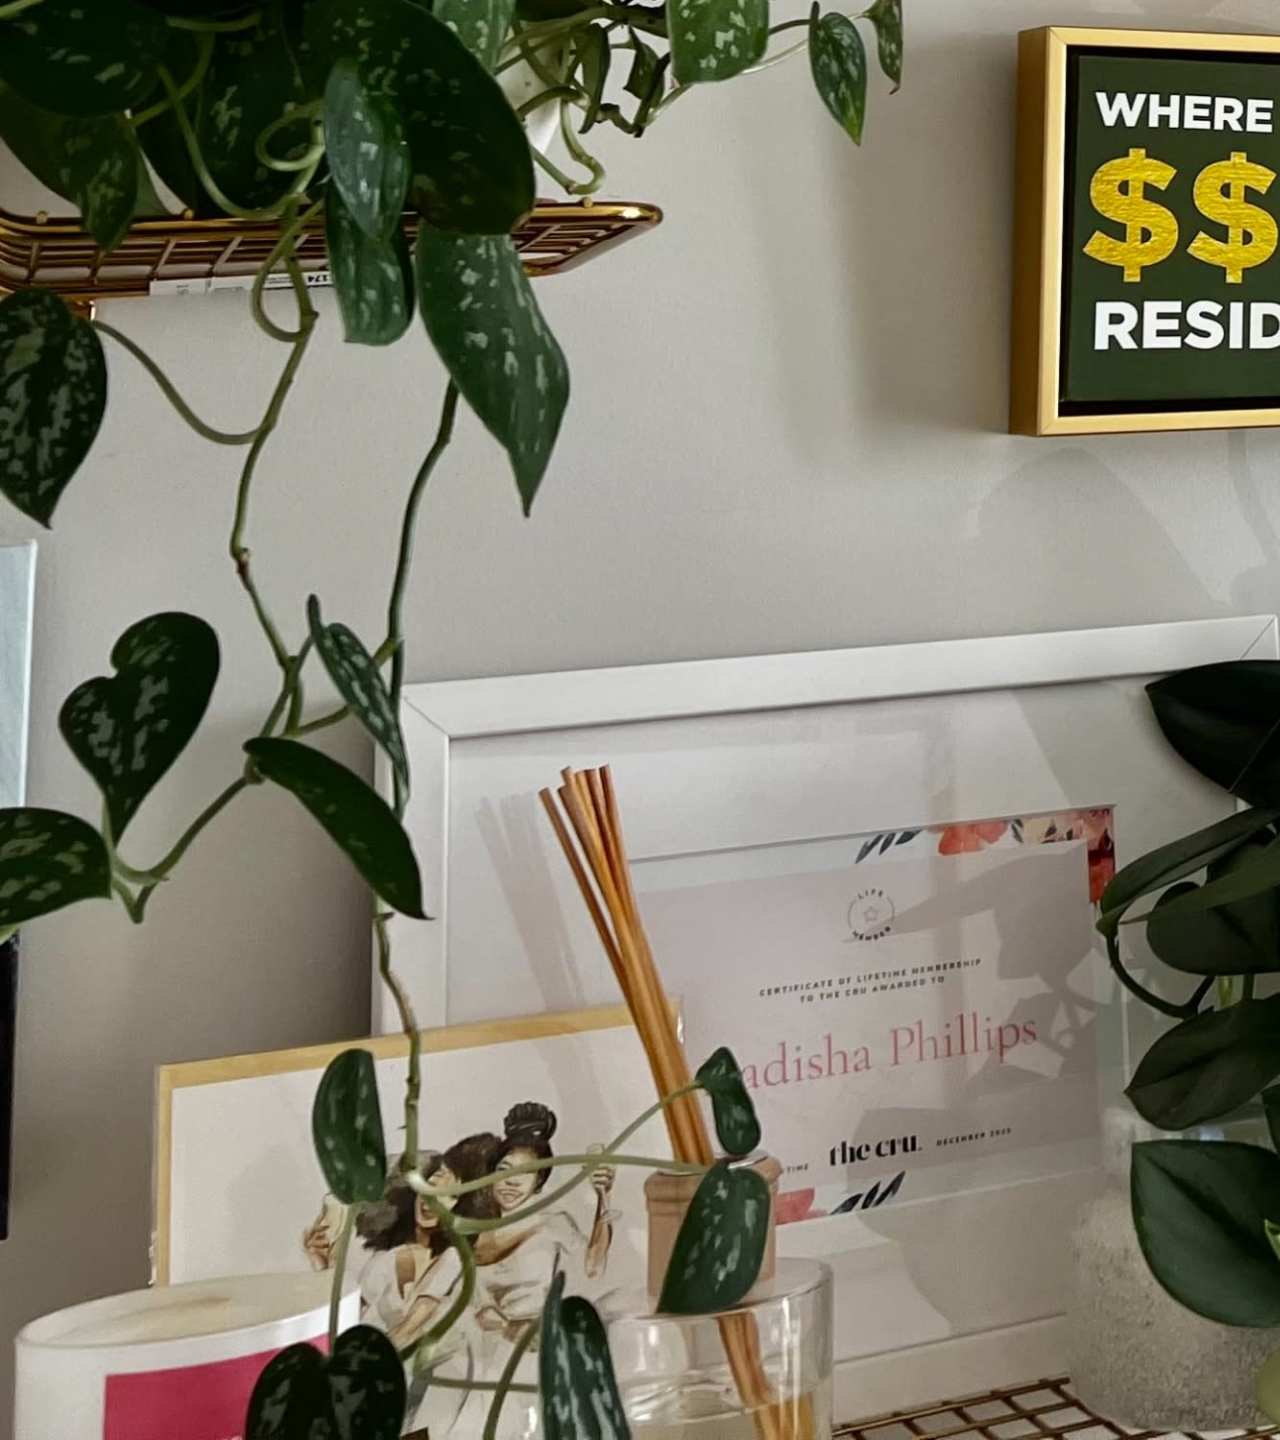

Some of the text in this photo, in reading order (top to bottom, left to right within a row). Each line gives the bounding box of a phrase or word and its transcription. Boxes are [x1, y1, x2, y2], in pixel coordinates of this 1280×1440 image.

[1095, 91, 1273, 134] WHERE
[857, 888, 884, 900] LIFE
[759, 958, 982, 997] CERTIFICATE OF LIFETIME MEMBERSHIP
[800, 994, 814, 1004] TO
[819, 990, 840, 1001] THE
[872, 979, 926, 993] AWARDED
[931, 975, 945, 985] TO
[740, 1010, 1037, 1089] adisha Phillips
[829, 1140, 869, 1168] the
